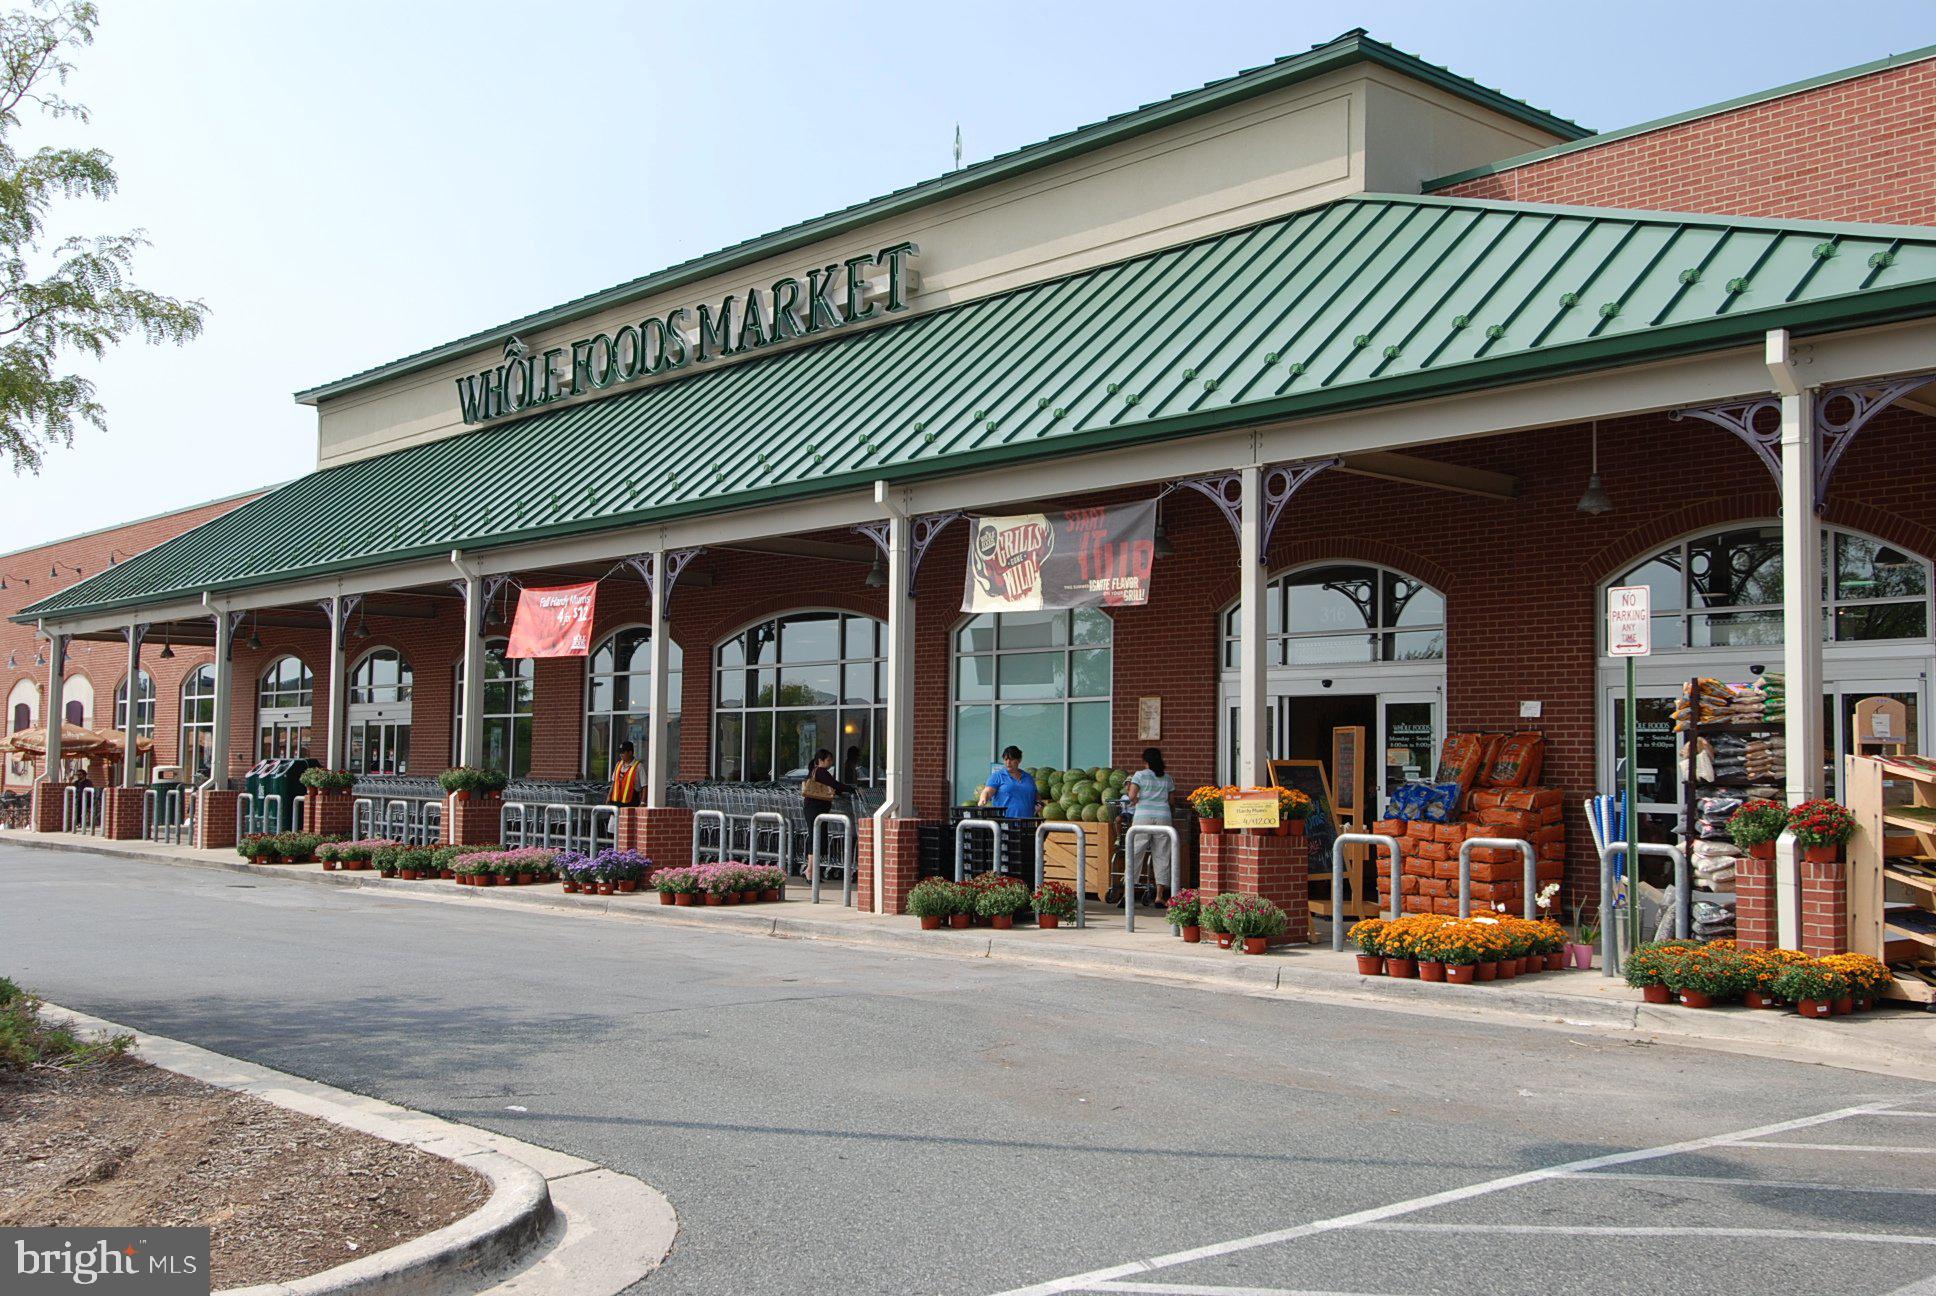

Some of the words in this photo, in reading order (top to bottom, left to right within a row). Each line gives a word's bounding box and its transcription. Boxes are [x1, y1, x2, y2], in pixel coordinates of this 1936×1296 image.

[570, 308, 690, 395] FOODS
[696, 241, 920, 363] MARKET
[997, 525, 1042, 567] GRILLS
[1089, 578, 1111, 592] IGNITE
[1111, 576, 1139, 590] FLAVOR
[1123, 589, 1145, 602] GRILL!
[1622, 594, 1636, 606] NO
[1612, 609, 1646, 621] PARKING
[1622, 623, 1636, 632] ANY
[1622, 633, 1637, 642] TIME
[1651, 741, 1675, 749] 9:00pm
